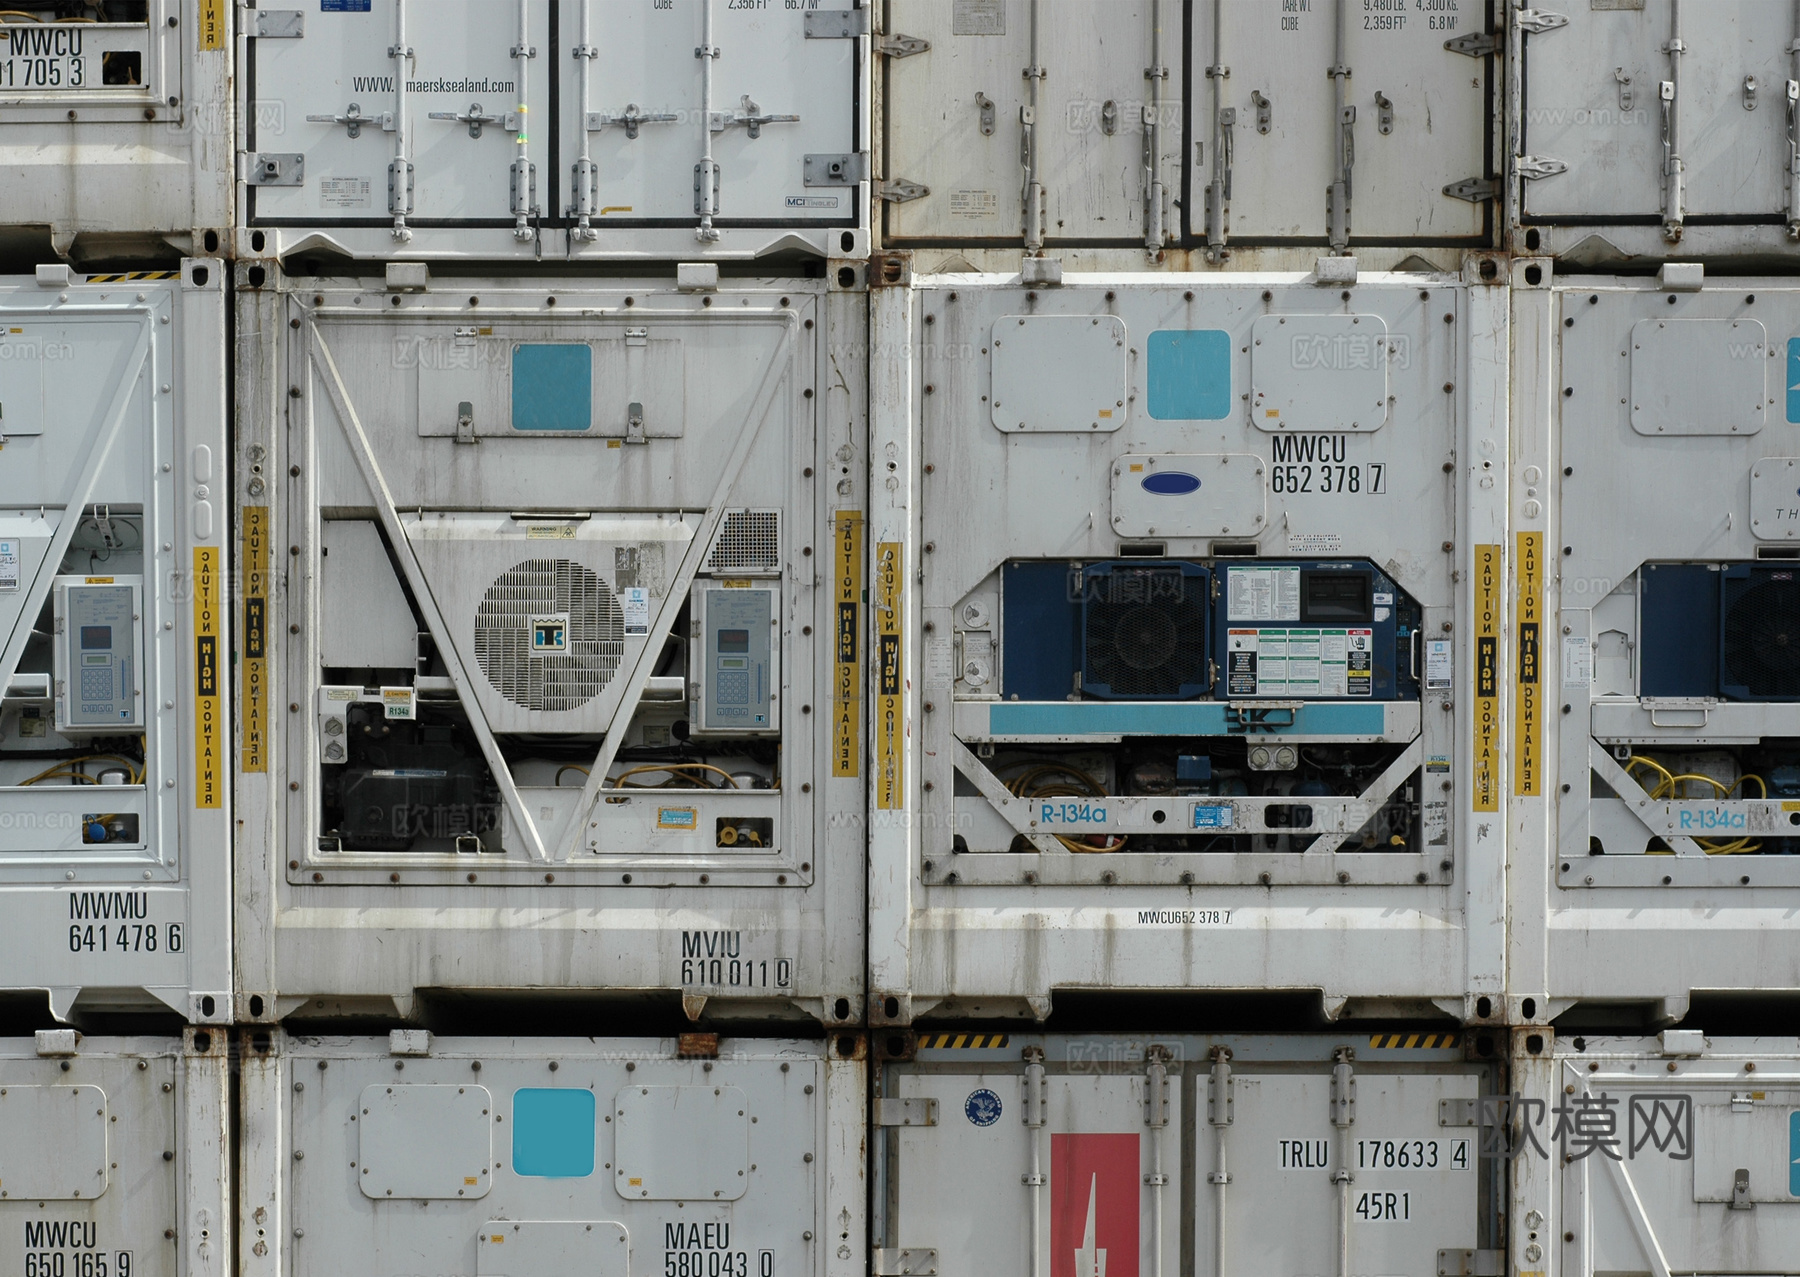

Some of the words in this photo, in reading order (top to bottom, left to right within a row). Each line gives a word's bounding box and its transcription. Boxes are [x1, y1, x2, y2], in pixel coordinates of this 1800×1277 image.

[653, 0, 673, 10] CUBE
[1364, 0, 1392, 12] 9,480
[1416, 0, 1446, 12] 4,300
[1281, 16, 1299, 31] CUBE
[1363, 15, 1393, 31] 2,359
[1429, 15, 1446, 30] 6.8
[10, 28, 82, 56] MWCU
[23, 58, 61, 87] 705
[353, 76, 395, 93] WWW.
[405, 77, 515, 93] maersksealand.com
[786, 198, 806, 206] MCI
[1271, 435, 1346, 463] MWCU
[1271, 465, 1313, 494] 652
[1319, 465, 1361, 494] 378
[1041, 803, 1107, 824] R-134a
[1679, 810, 1746, 829] R-134a
[69, 892, 148, 919] MWMU
[1199, 910, 1220, 924] 378
[69, 924, 108, 952] 641
[116, 924, 158, 952] 478
[681, 930, 741, 958] MVIU
[1279, 1140, 1329, 1168] TRLU
[1357, 1140, 1440, 1169] 178633
[1453, 1141, 1467, 1168] 4
[1355, 1192, 1410, 1220] 45R1
[25, 1221, 97, 1249] MWCU
[665, 1222, 730, 1249] MAEU
[25, 1252, 65, 1277] 650
[72, 1252, 108, 1277] 165
[117, 1252, 131, 1277] 9
[664, 1251, 702, 1277] 580
[708, 1251, 748, 1277] 043
[760, 1251, 773, 1277] 0
